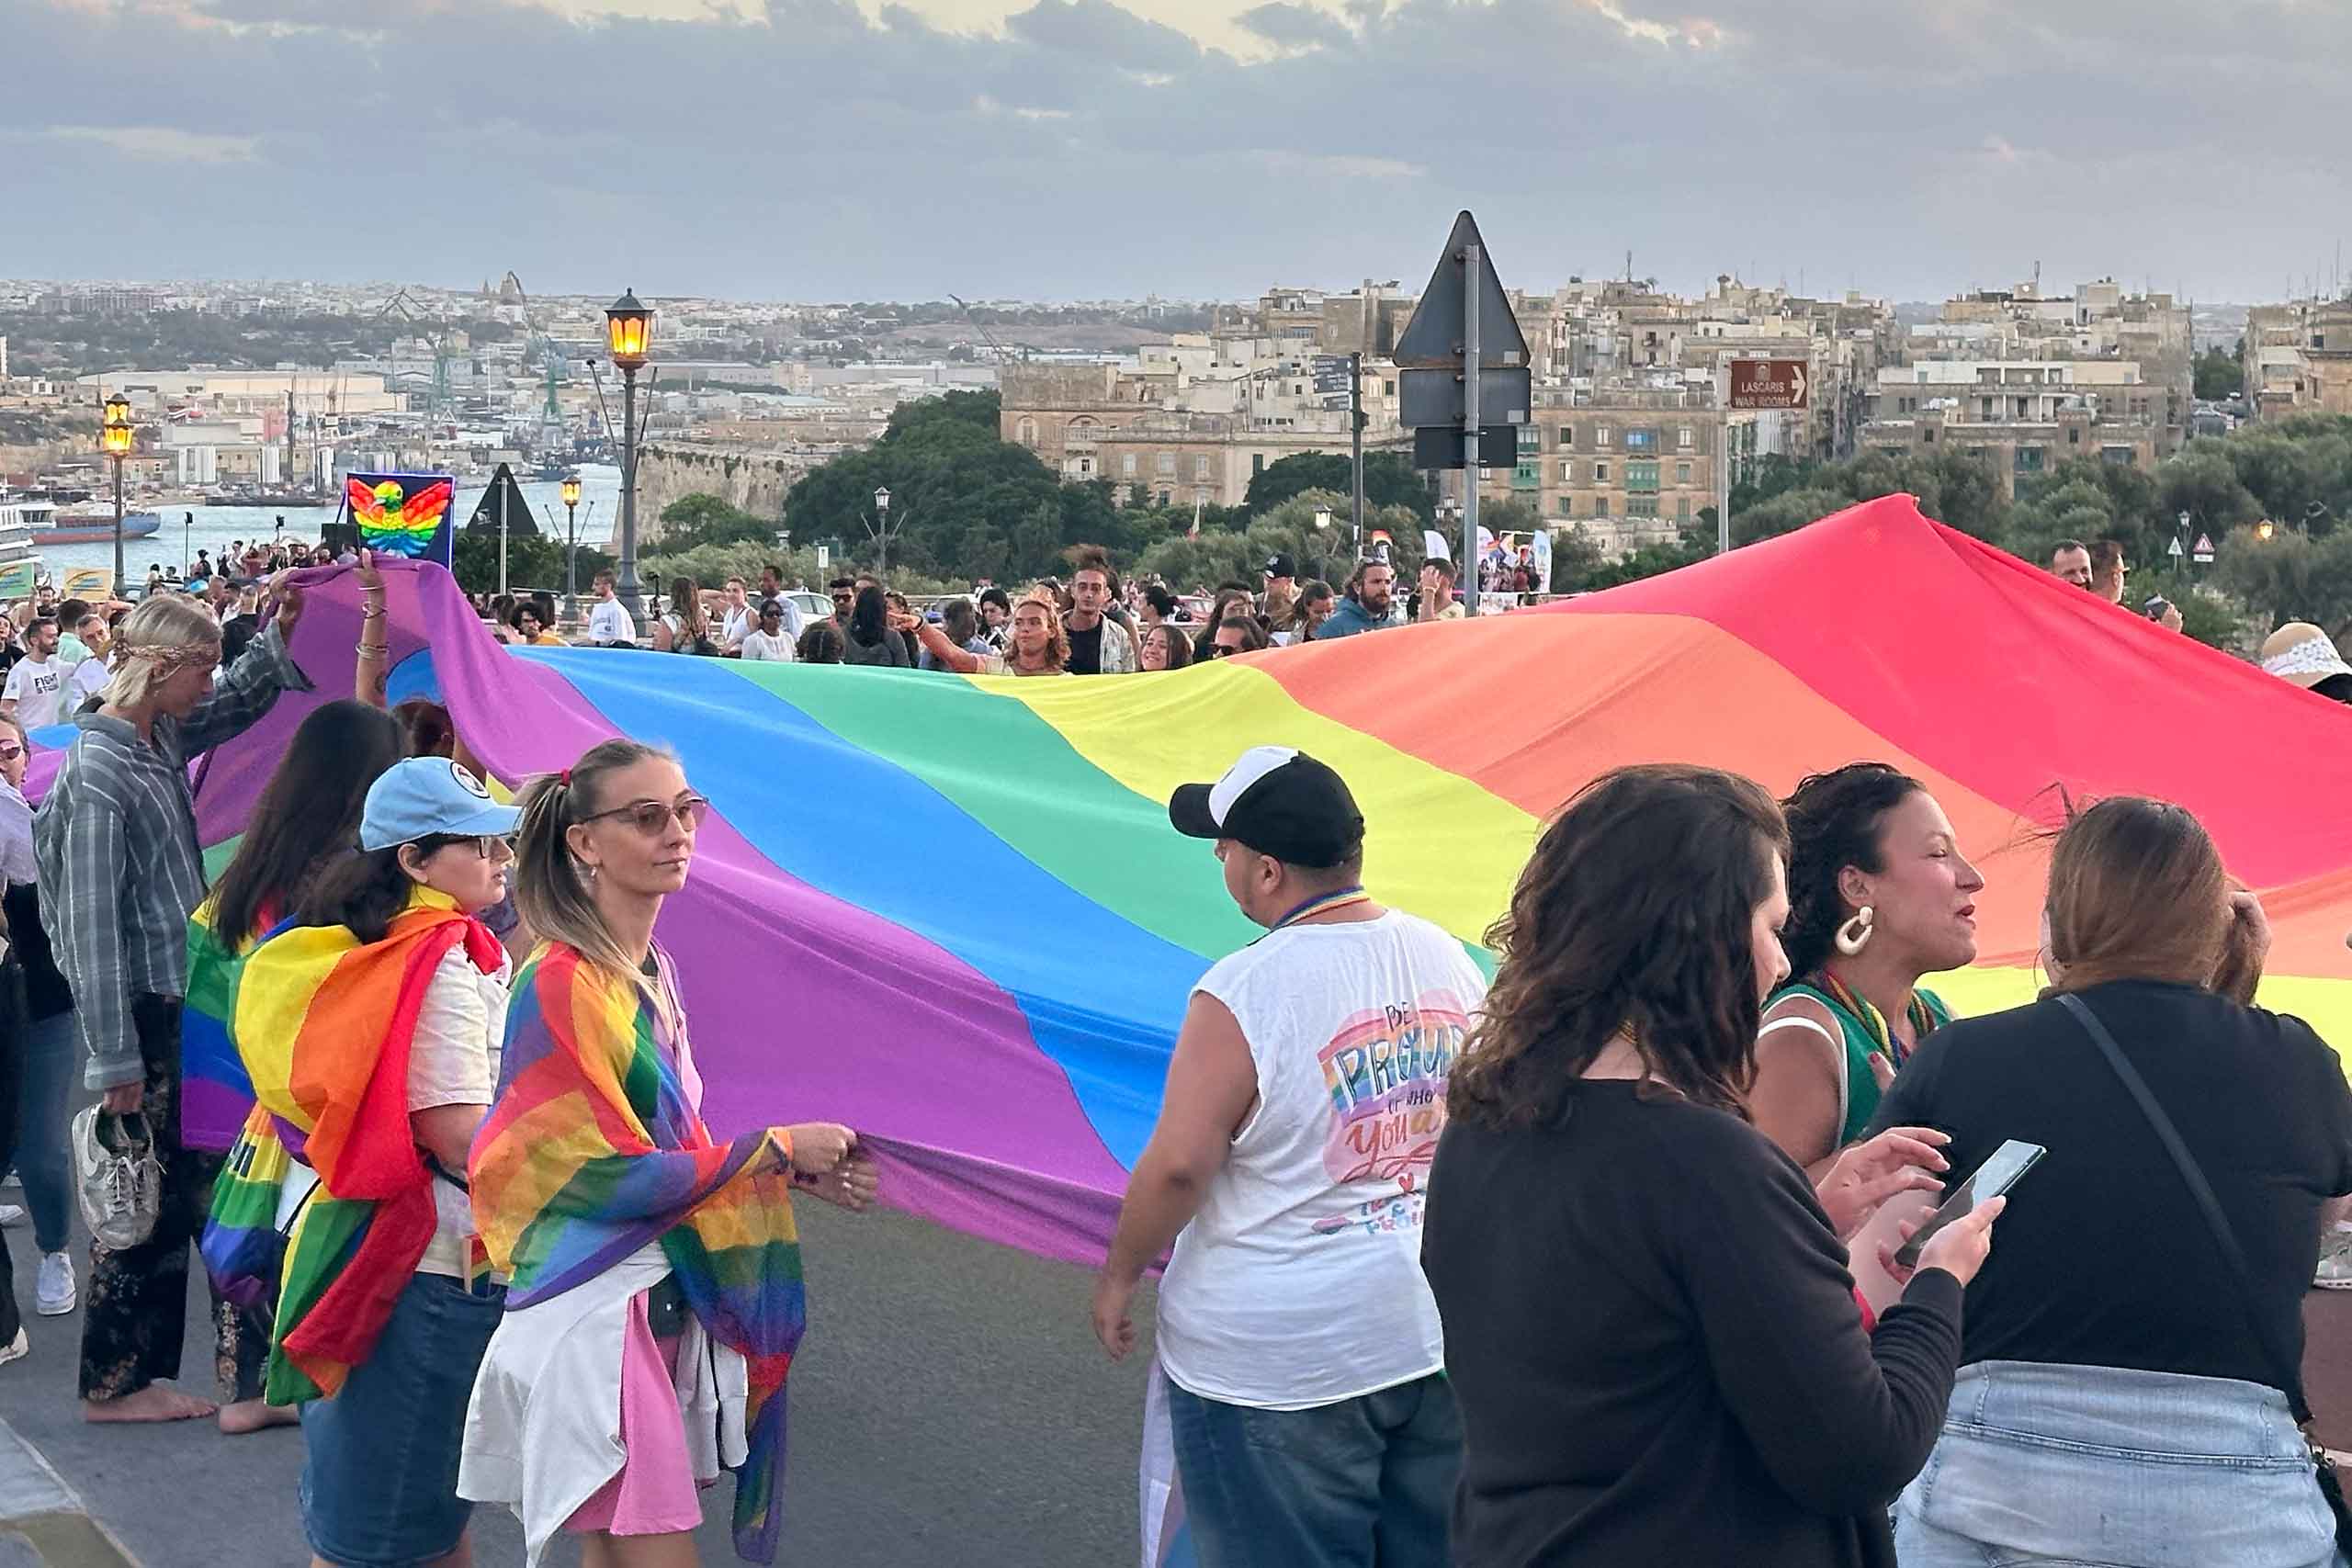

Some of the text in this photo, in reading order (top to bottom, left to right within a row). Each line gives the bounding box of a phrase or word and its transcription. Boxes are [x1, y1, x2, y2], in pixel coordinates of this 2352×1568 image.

[1741, 381, 1785, 394] LASCARIS
[1734, 396, 1791, 407] WAR ROOMS
[1385, 1001, 1413, 1031] BE
